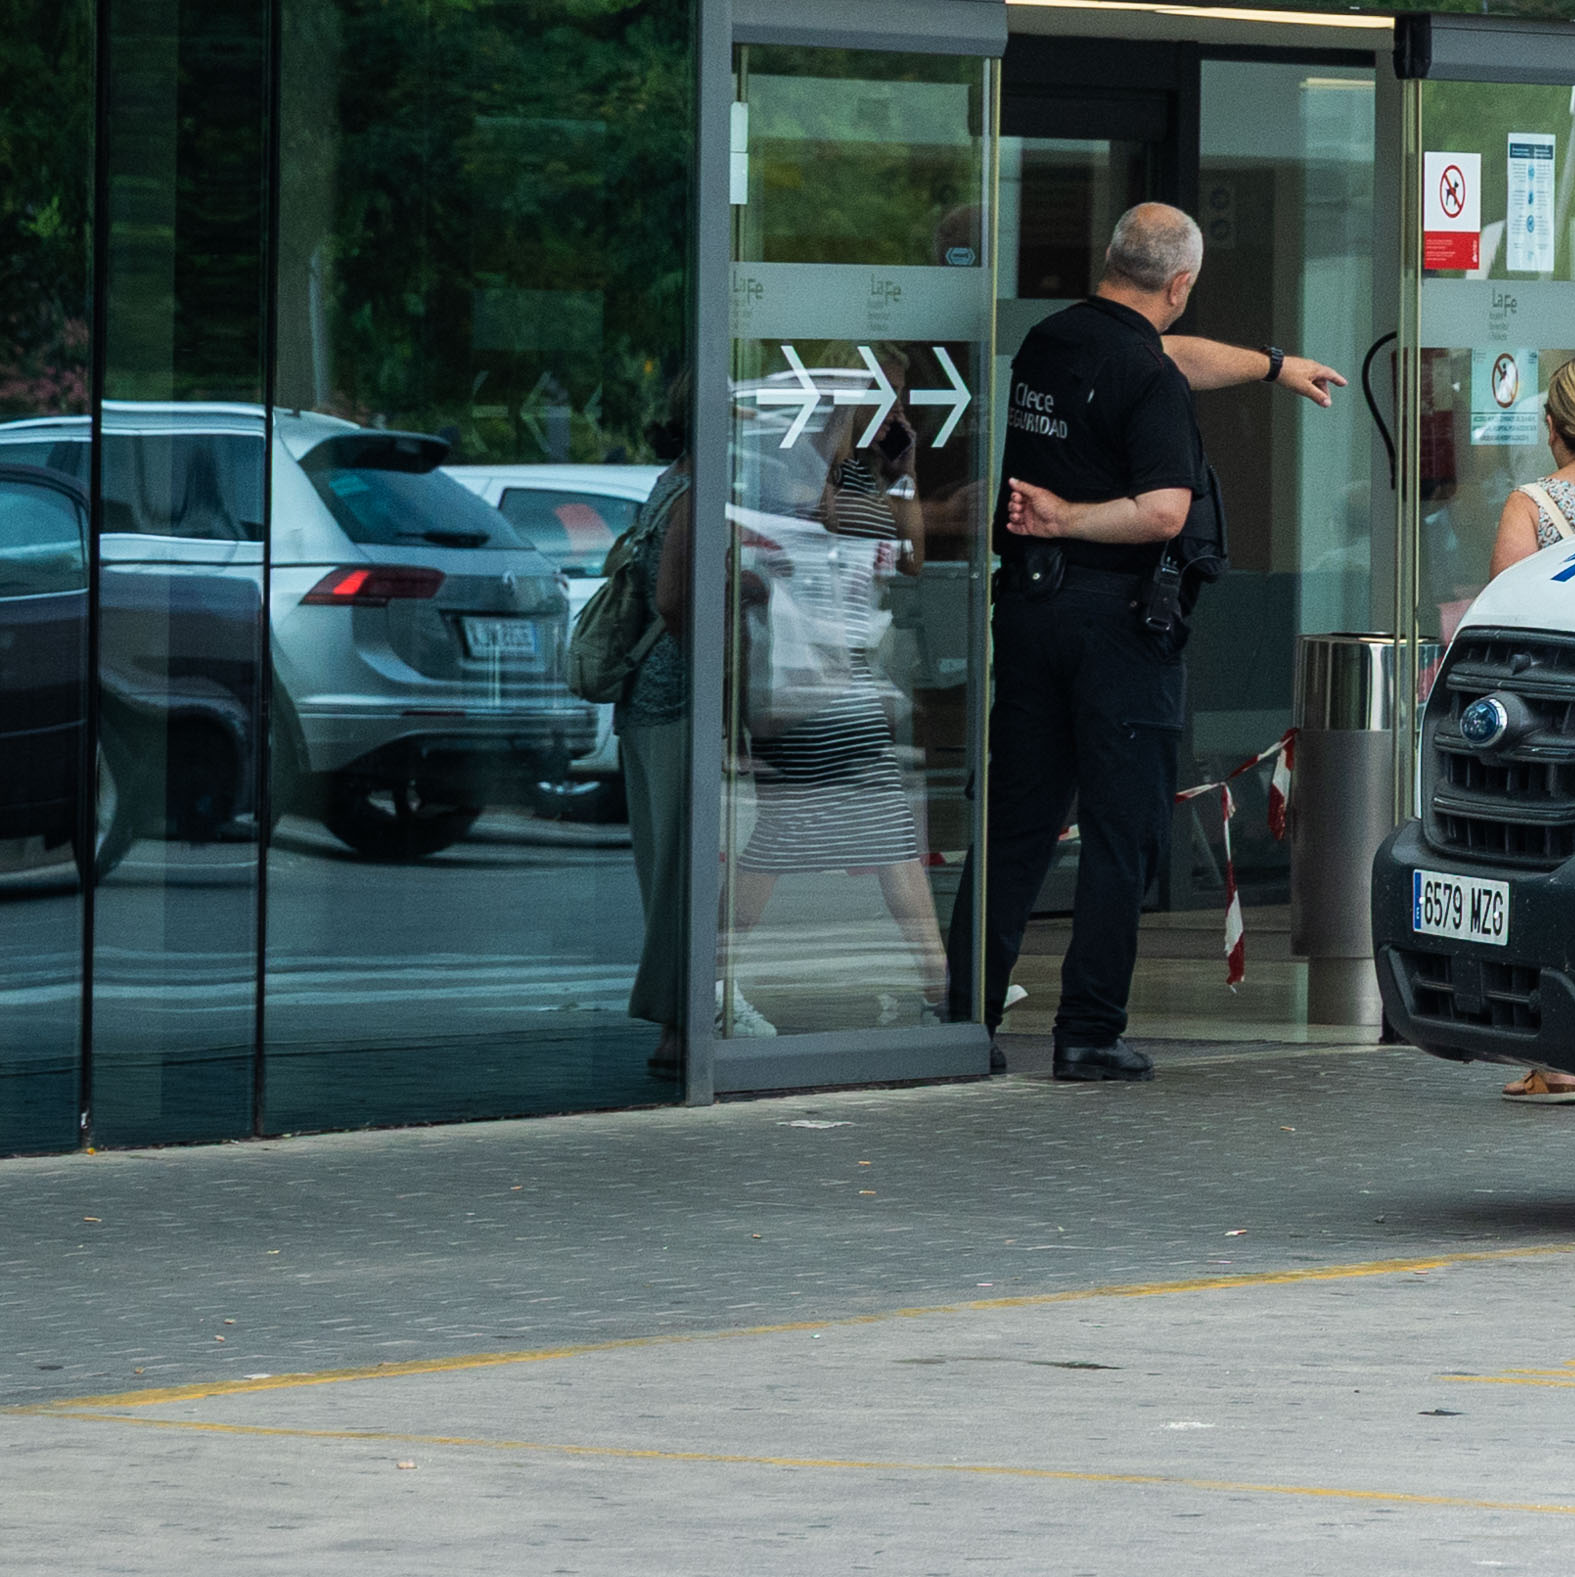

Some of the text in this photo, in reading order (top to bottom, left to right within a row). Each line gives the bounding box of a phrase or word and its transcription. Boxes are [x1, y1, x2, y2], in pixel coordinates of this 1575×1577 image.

[1016, 383, 1054, 413] Clece
[1009, 408, 1068, 439] EGURIDAD
[1424, 880, 1504, 936] 6579 MZG
